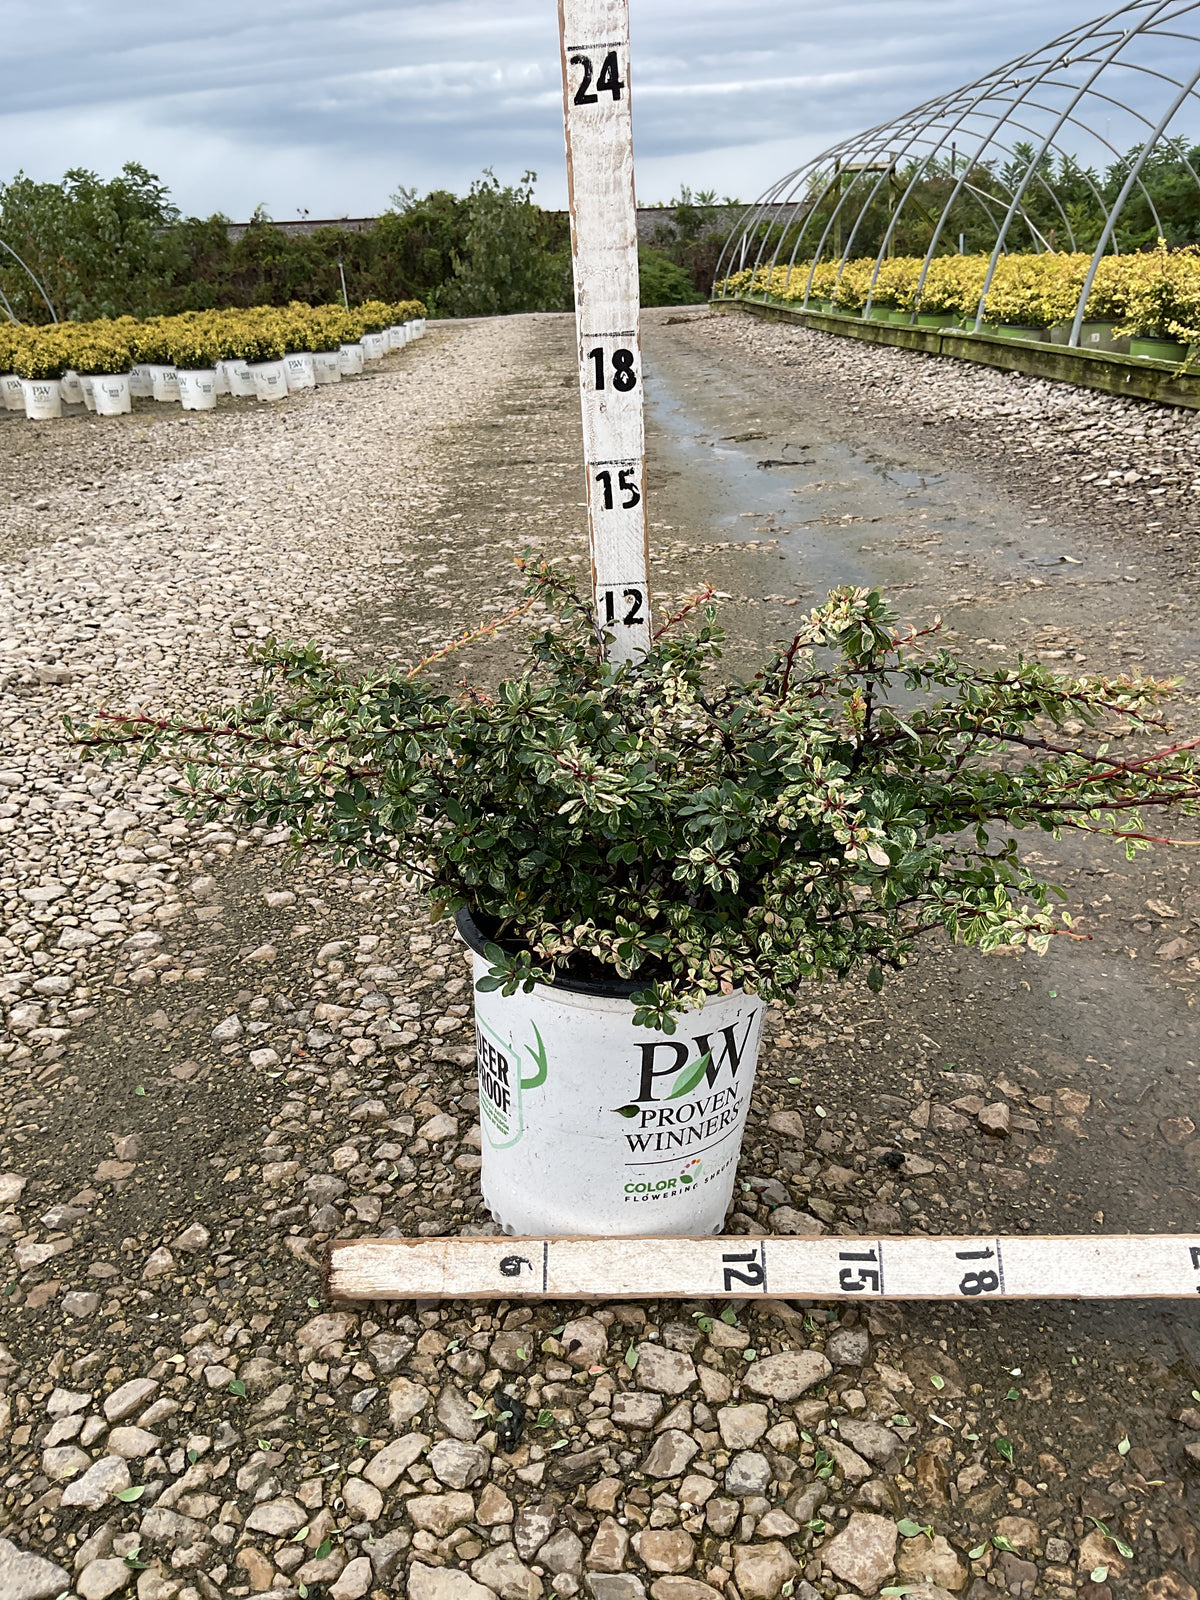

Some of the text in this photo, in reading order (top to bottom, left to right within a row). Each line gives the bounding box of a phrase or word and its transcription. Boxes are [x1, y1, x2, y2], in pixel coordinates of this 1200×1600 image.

[570, 51, 624, 105] 24
[588, 347, 636, 392] 18
[595, 467, 641, 510] 15
[600, 588, 644, 626] 12
[624, 1100, 740, 1153] WINNERS
[638, 1081, 740, 1129] PROVEN
[624, 1178, 677, 1193] COLOR
[500, 1256, 533, 1277] 6
[722, 1249, 765, 1291] 12
[838, 1249, 879, 1291] 15
[955, 1246, 999, 1295] 18
